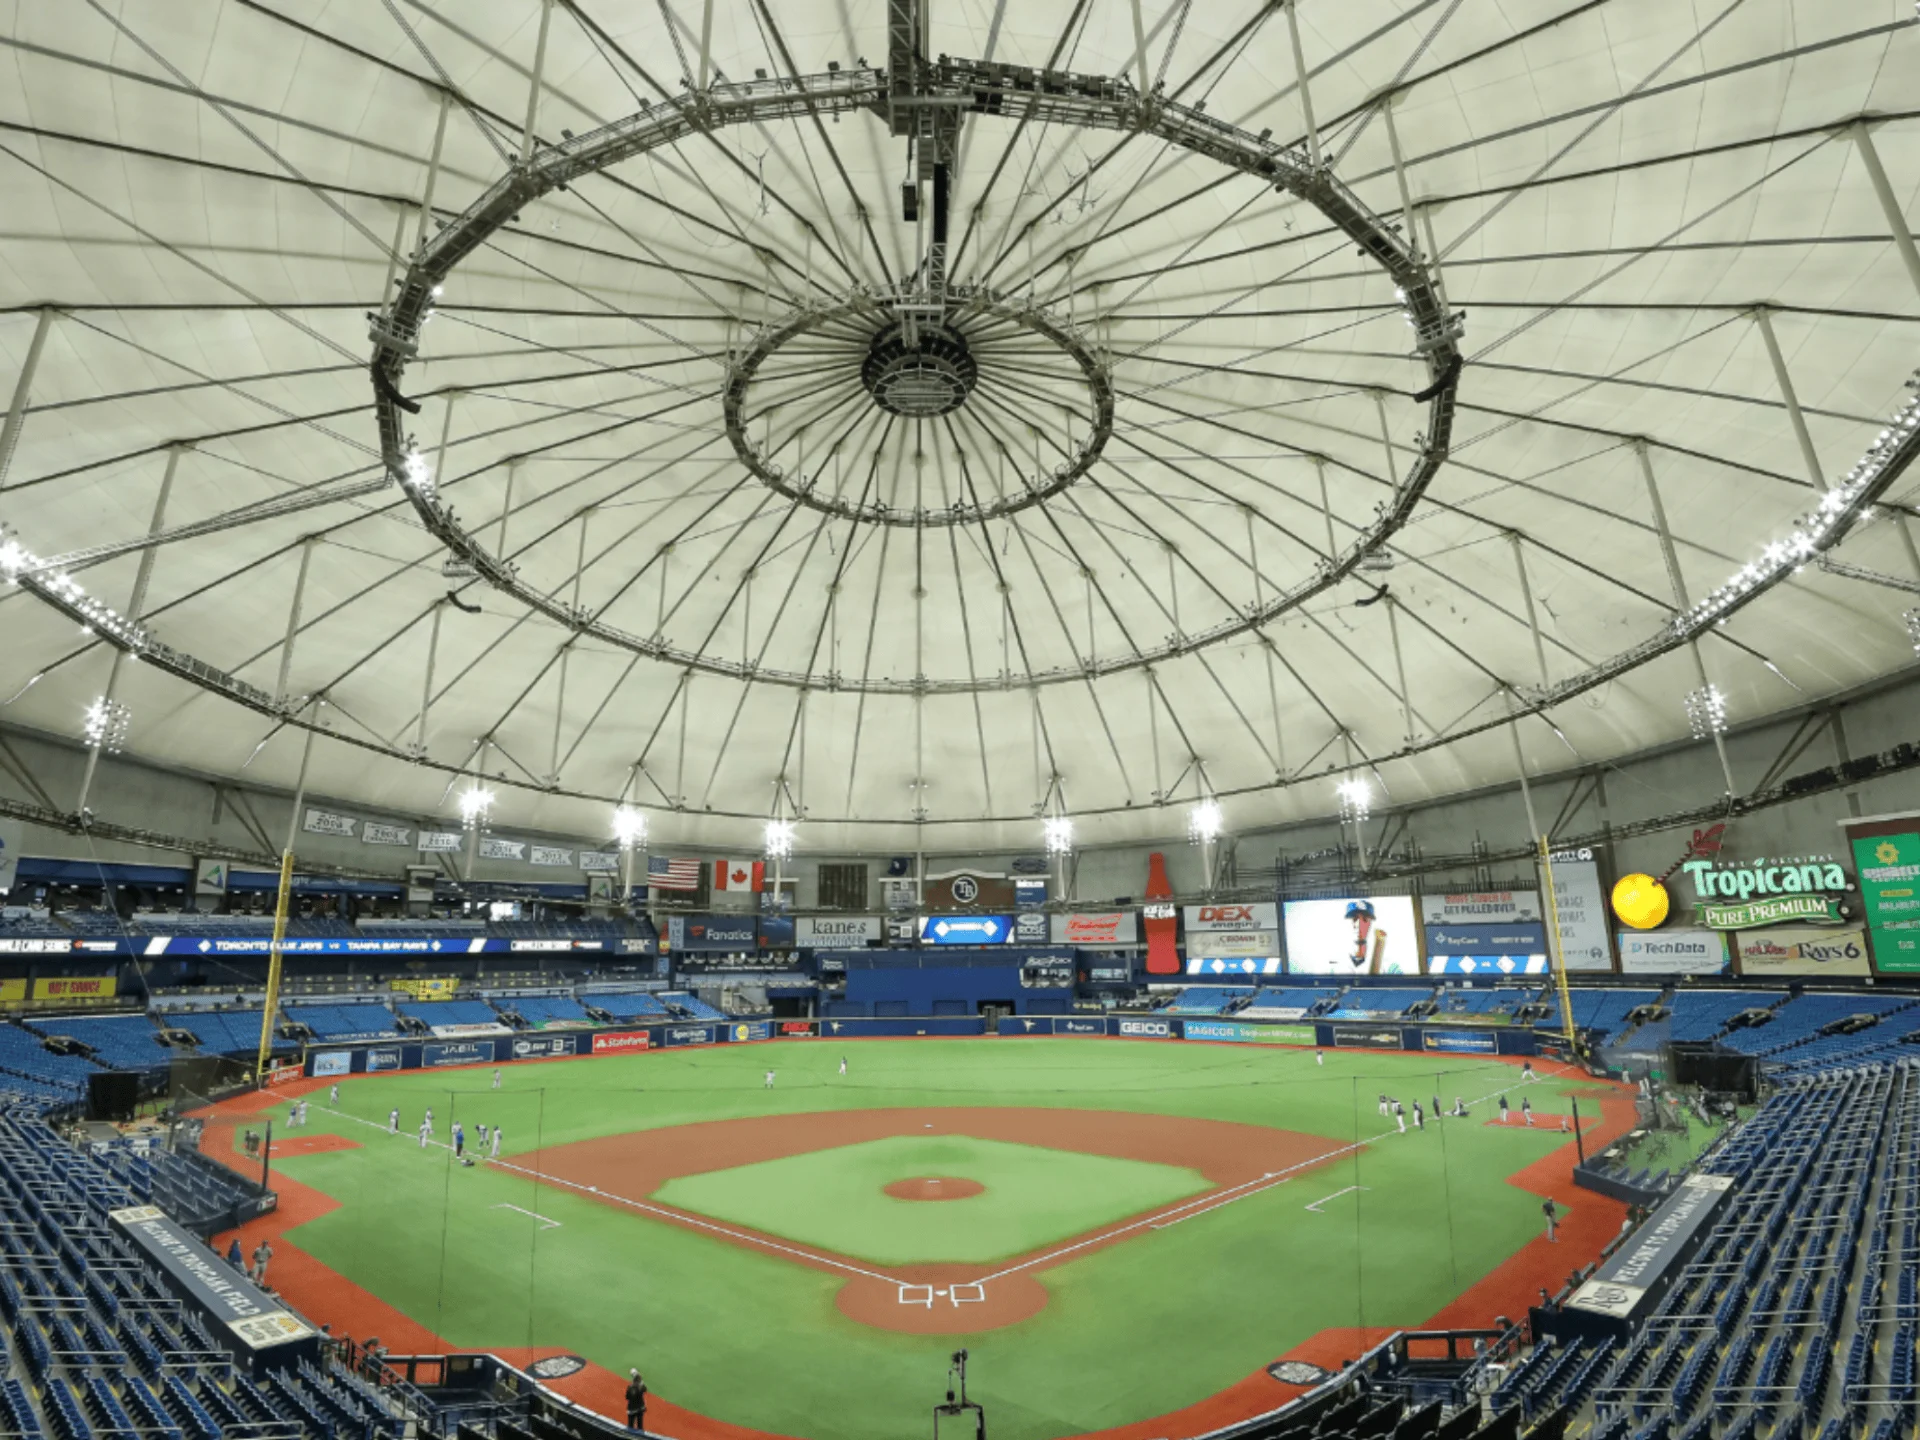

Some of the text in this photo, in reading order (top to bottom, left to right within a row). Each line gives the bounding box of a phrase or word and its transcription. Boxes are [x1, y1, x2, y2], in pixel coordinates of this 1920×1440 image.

[1683, 860, 1847, 900] Tropicana
[1198, 906, 1255, 922] DEX
[1706, 898, 1828, 925] PURE PREMIUM
[812, 919, 866, 934] kanes
[1017, 924, 1046, 934] ROSE
[707, 929, 753, 940] Fanatics
[216, 941, 268, 951] TORONTO
[299, 941, 323, 951] JAYS
[347, 941, 381, 951] TAMPA
[382, 941, 401, 951] BAY
[1845, 940, 1861, 959] 6
[1121, 1022, 1168, 1035] GEICO
[1188, 1025, 1235, 1037] SAGICOR
[441, 1043, 478, 1055] JABIL
